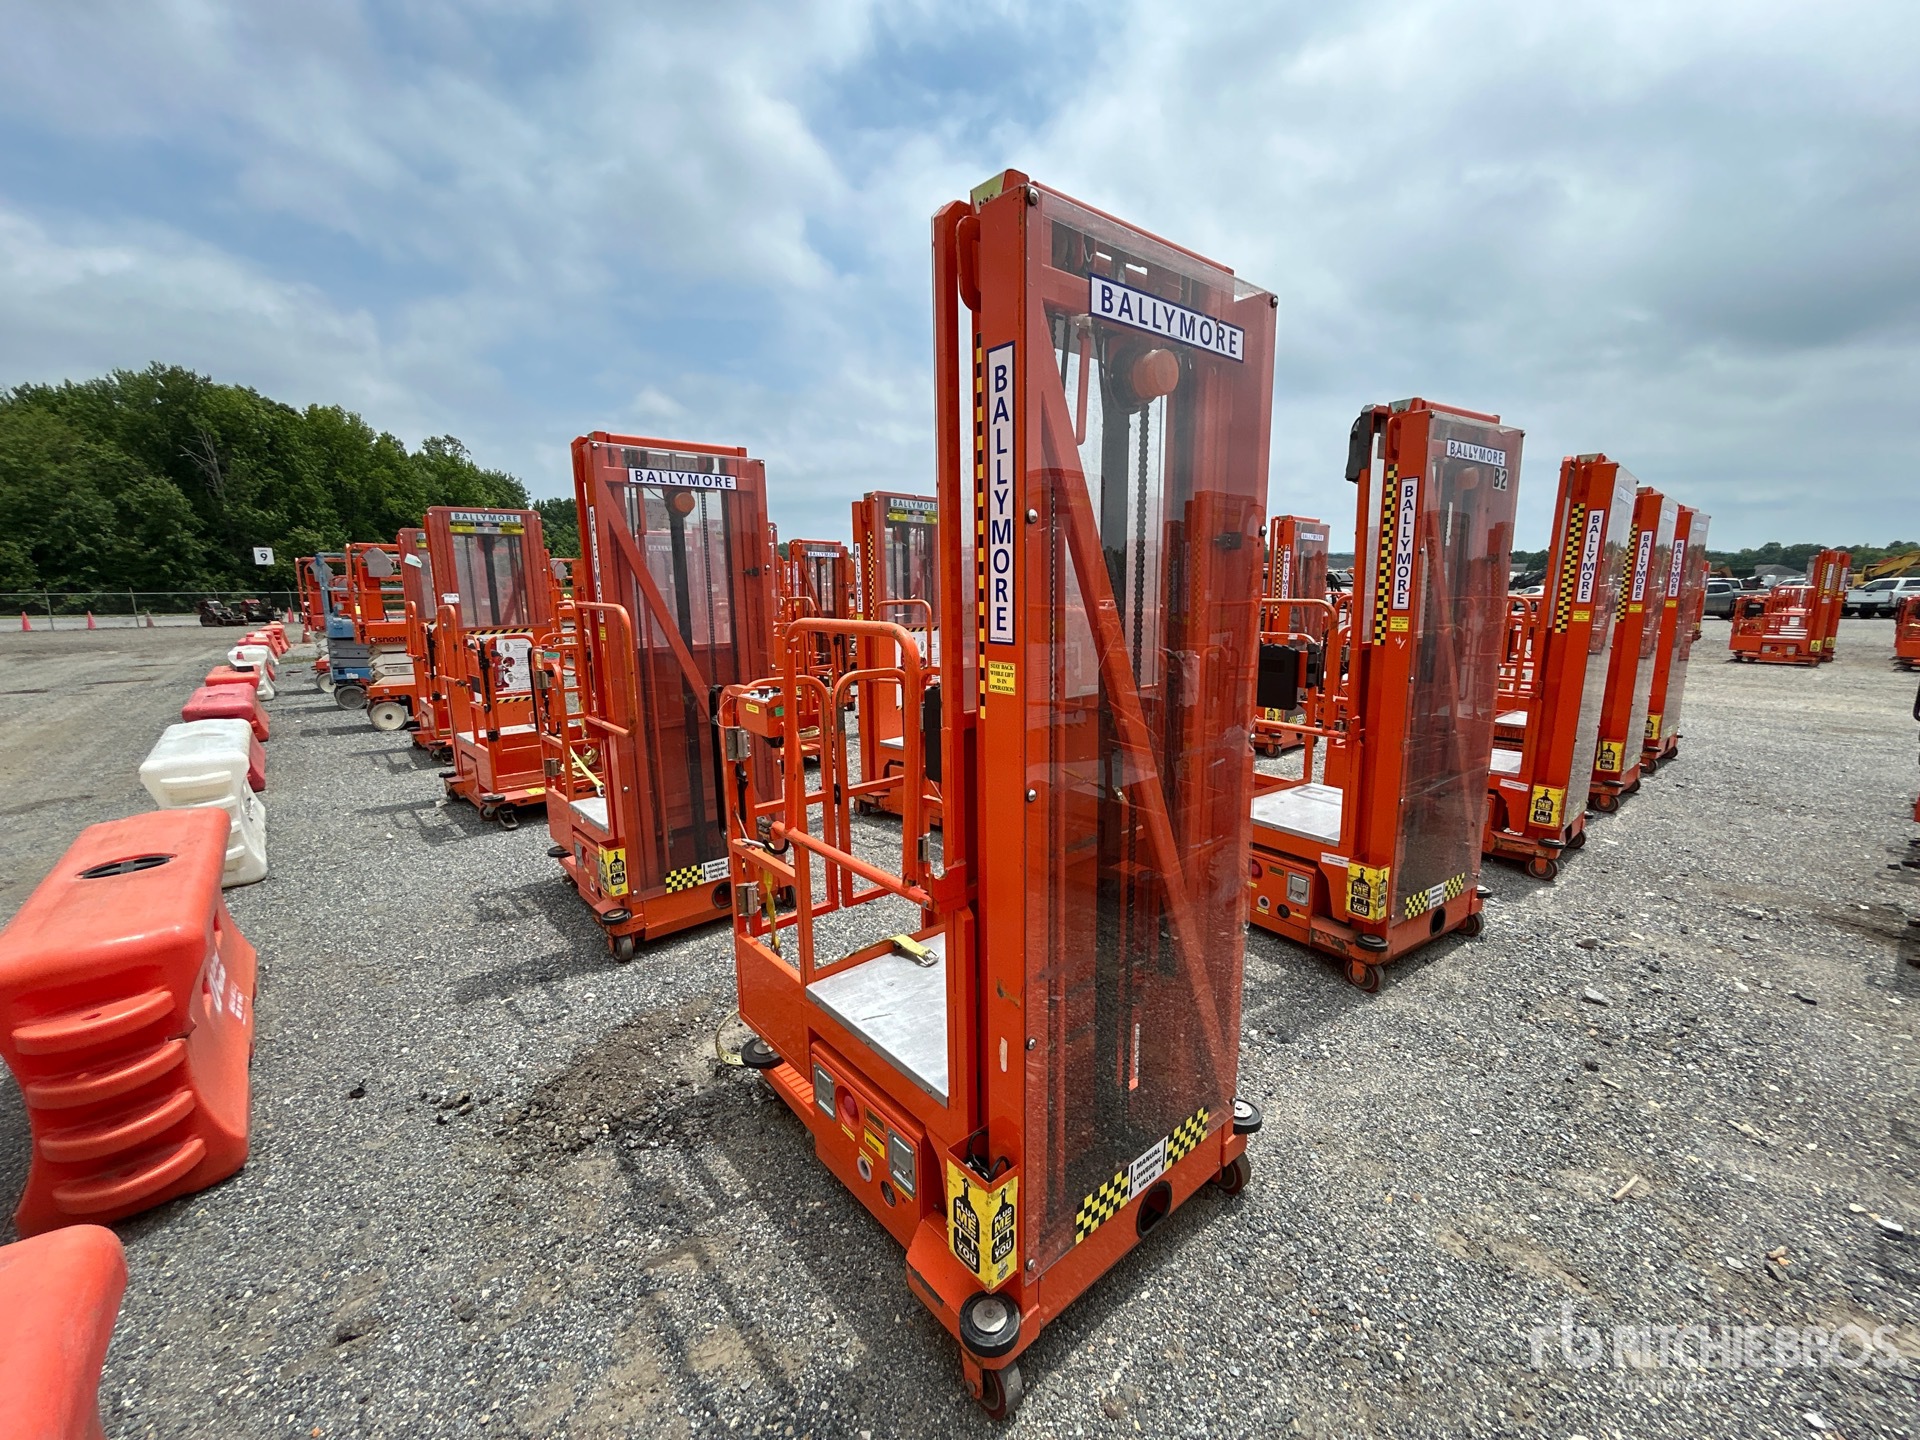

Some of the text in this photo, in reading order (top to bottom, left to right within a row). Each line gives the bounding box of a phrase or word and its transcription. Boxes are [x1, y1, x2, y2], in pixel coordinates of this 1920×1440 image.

[1100, 283, 1238, 356] BALLYMORE
[1450, 441, 1503, 465] BALLYMORE
[634, 469, 733, 490] BALLYMORE
[1493, 467, 1508, 490] B2
[992, 364, 1012, 632] BALLYMORE
[454, 513, 519, 522] BALLYMORE
[260, 552, 268, 561] 9
[1396, 485, 1413, 605] BALLYMORE
[1581, 515, 1600, 600] BALLYMORE
[1634, 534, 1650, 599] BALLYMORE
[1670, 542, 1682, 595] BALLYMORE
[1353, 886, 1369, 897] ME
[1352, 903, 1368, 912] YOU
[1133, 1156, 1163, 1182] LOWERING
[1136, 1147, 1161, 1170] MANUAL
[1138, 1170, 1157, 1188] VALVE
[956, 1199, 977, 1223] PLUG
[956, 1207, 977, 1236] ME
[994, 1206, 1012, 1224] PLUG
[994, 1212, 1012, 1235] ME
[956, 1240, 977, 1266] YOU
[994, 1240, 1012, 1258] YOU
